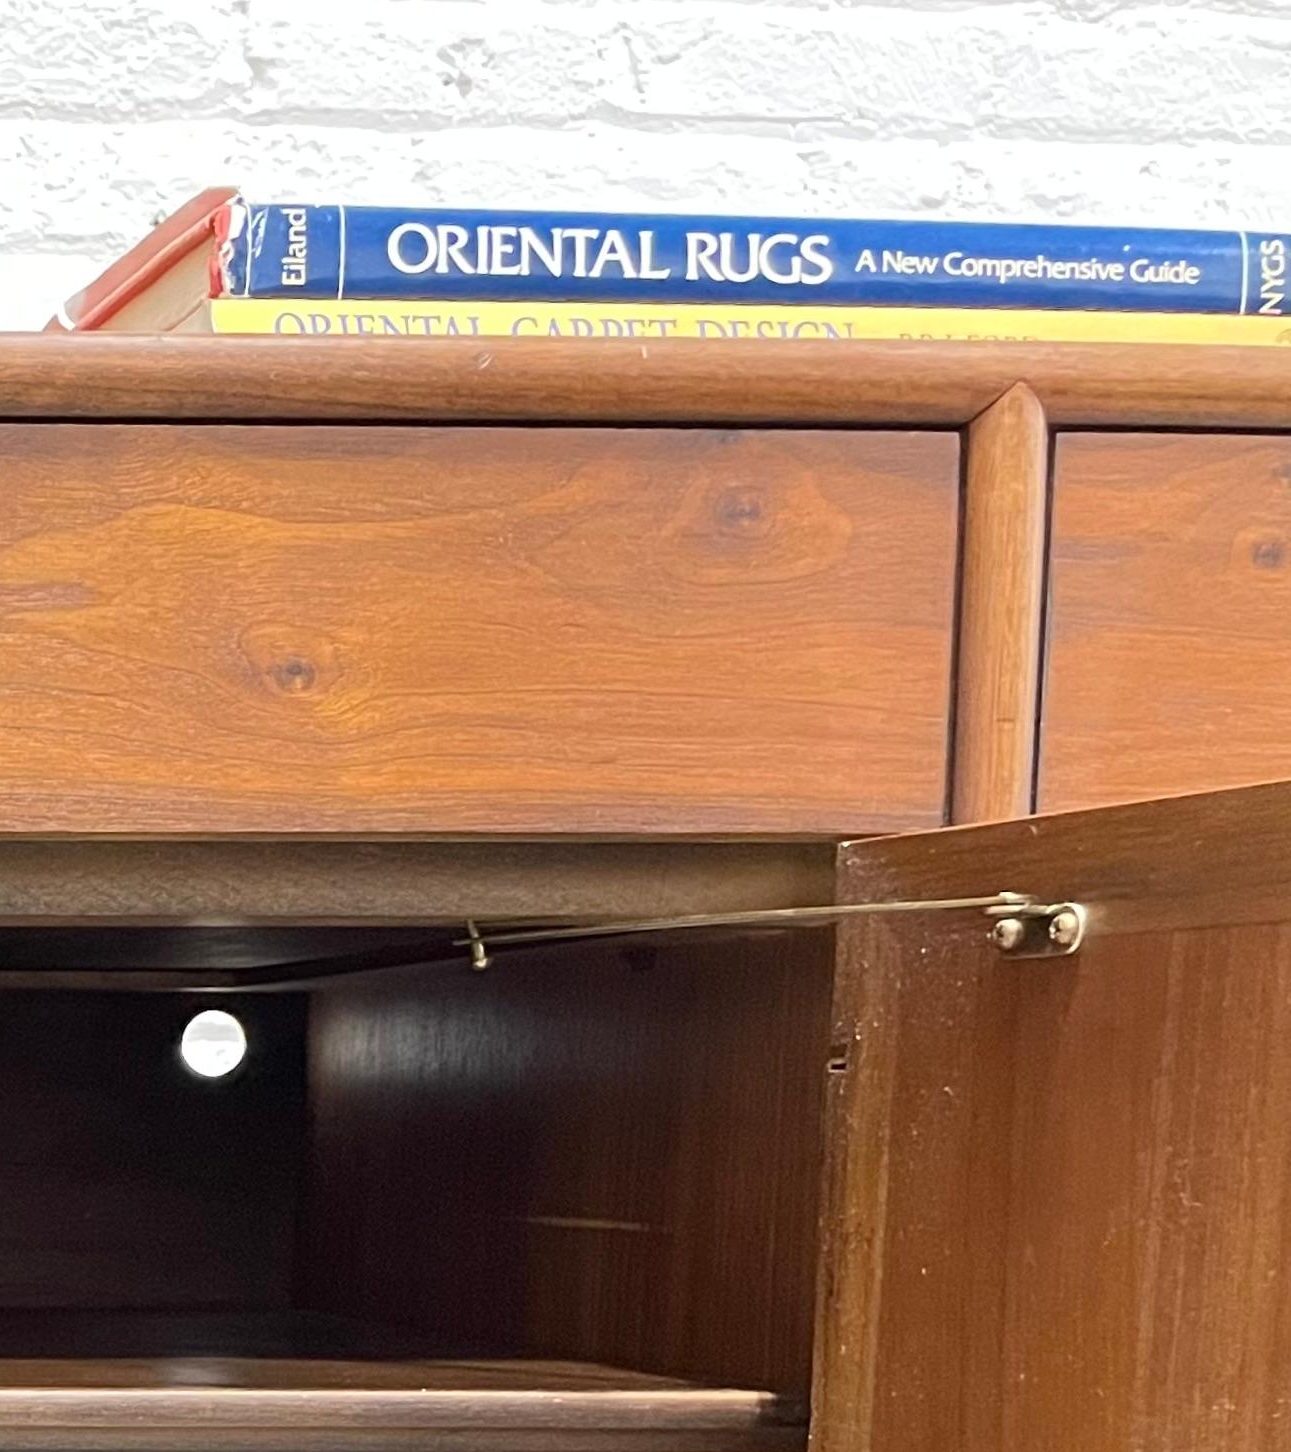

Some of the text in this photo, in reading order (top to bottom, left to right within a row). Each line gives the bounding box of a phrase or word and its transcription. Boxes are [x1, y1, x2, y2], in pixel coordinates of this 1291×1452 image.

[281, 207, 307, 286] Eiland
[386, 221, 835, 285] ORIENTAL RUGS
[854, 248, 1201, 286] A New Comprehensive Guide
[1258, 239, 1286, 316] NYGS
